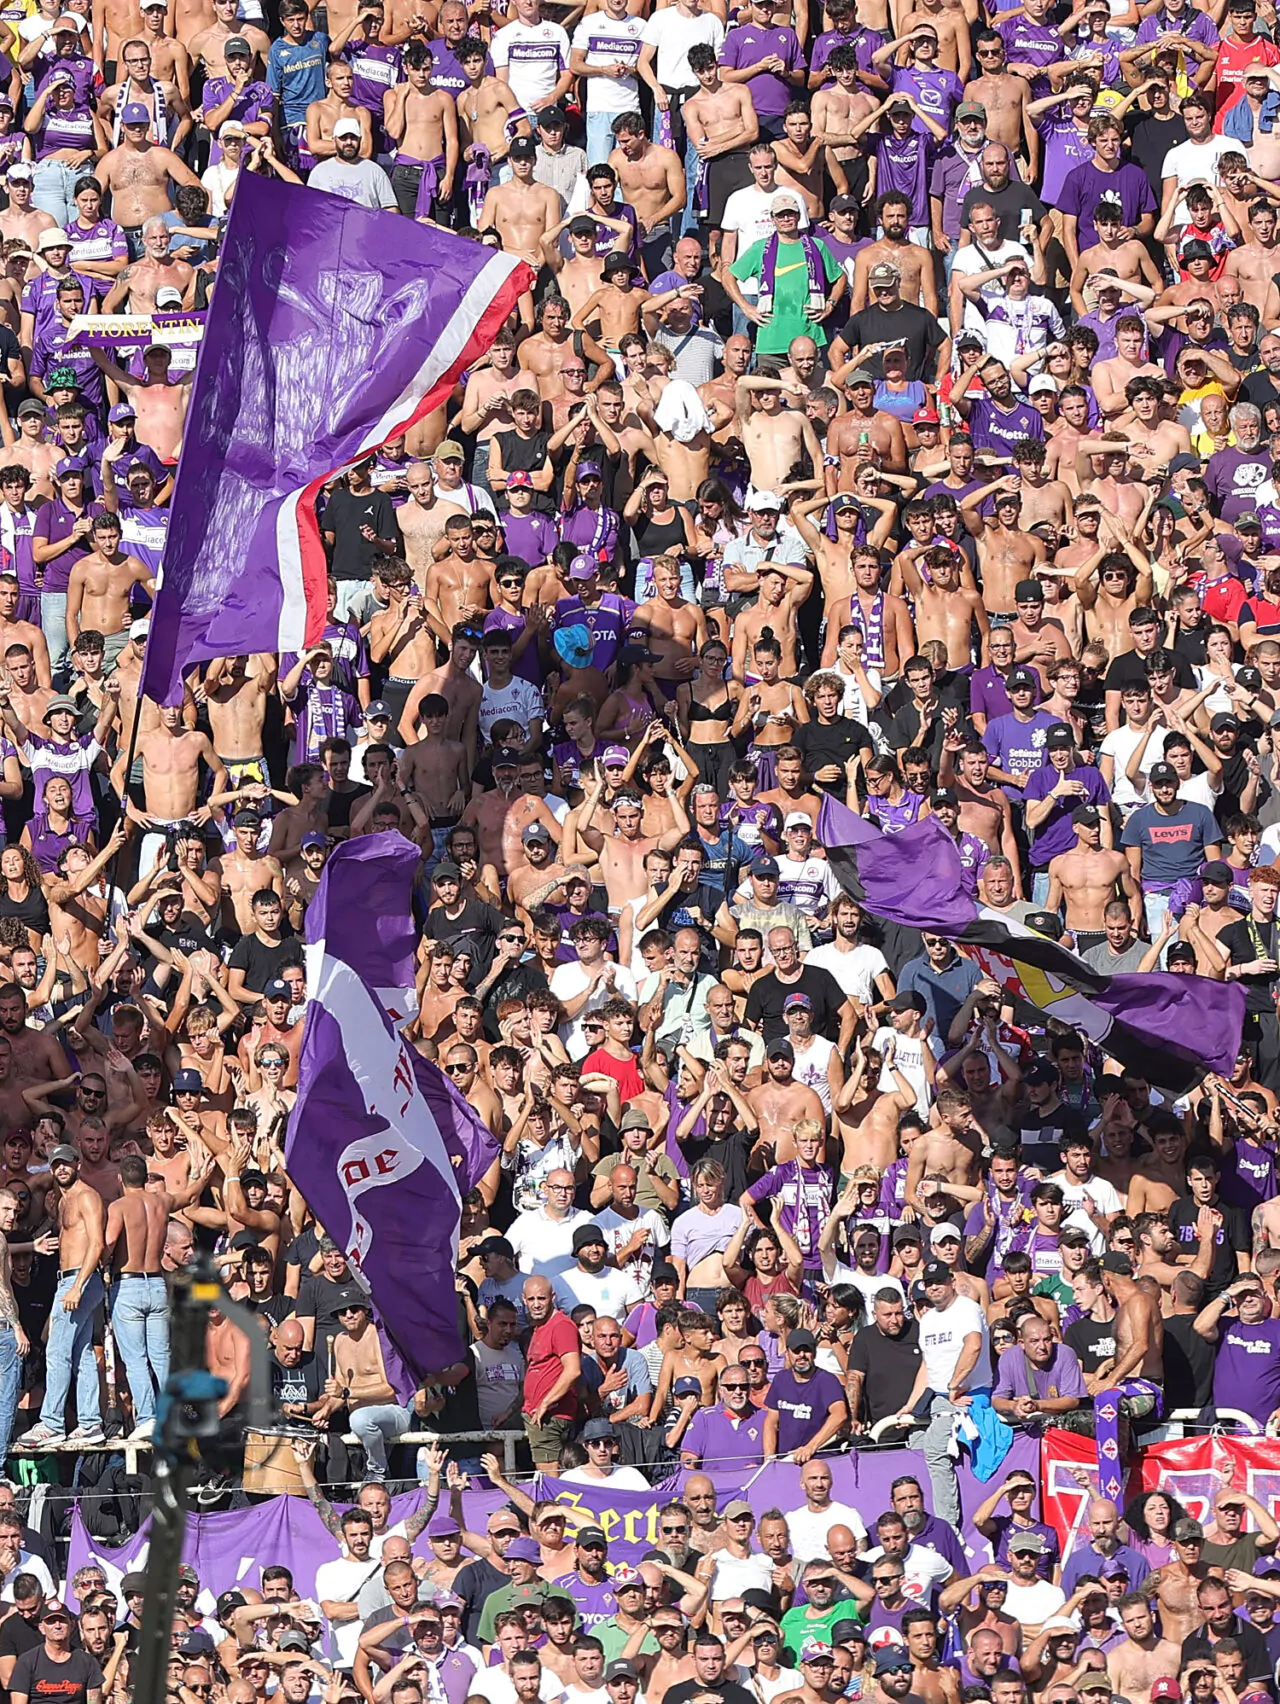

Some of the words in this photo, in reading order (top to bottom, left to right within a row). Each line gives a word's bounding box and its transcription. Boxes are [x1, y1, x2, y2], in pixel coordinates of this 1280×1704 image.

[597, 42, 635, 52] Mediacom
[1015, 40, 1057, 51] Mediacom
[513, 48, 553, 58] Mediacom
[283, 60, 322, 74] Mediacom
[429, 76, 465, 88] olletto
[88, 317, 200, 338] FIORENTIN
[593, 631, 617, 641] OTA
[480, 705, 518, 717] Mediacom
[555, 1491, 662, 1545] Sect
